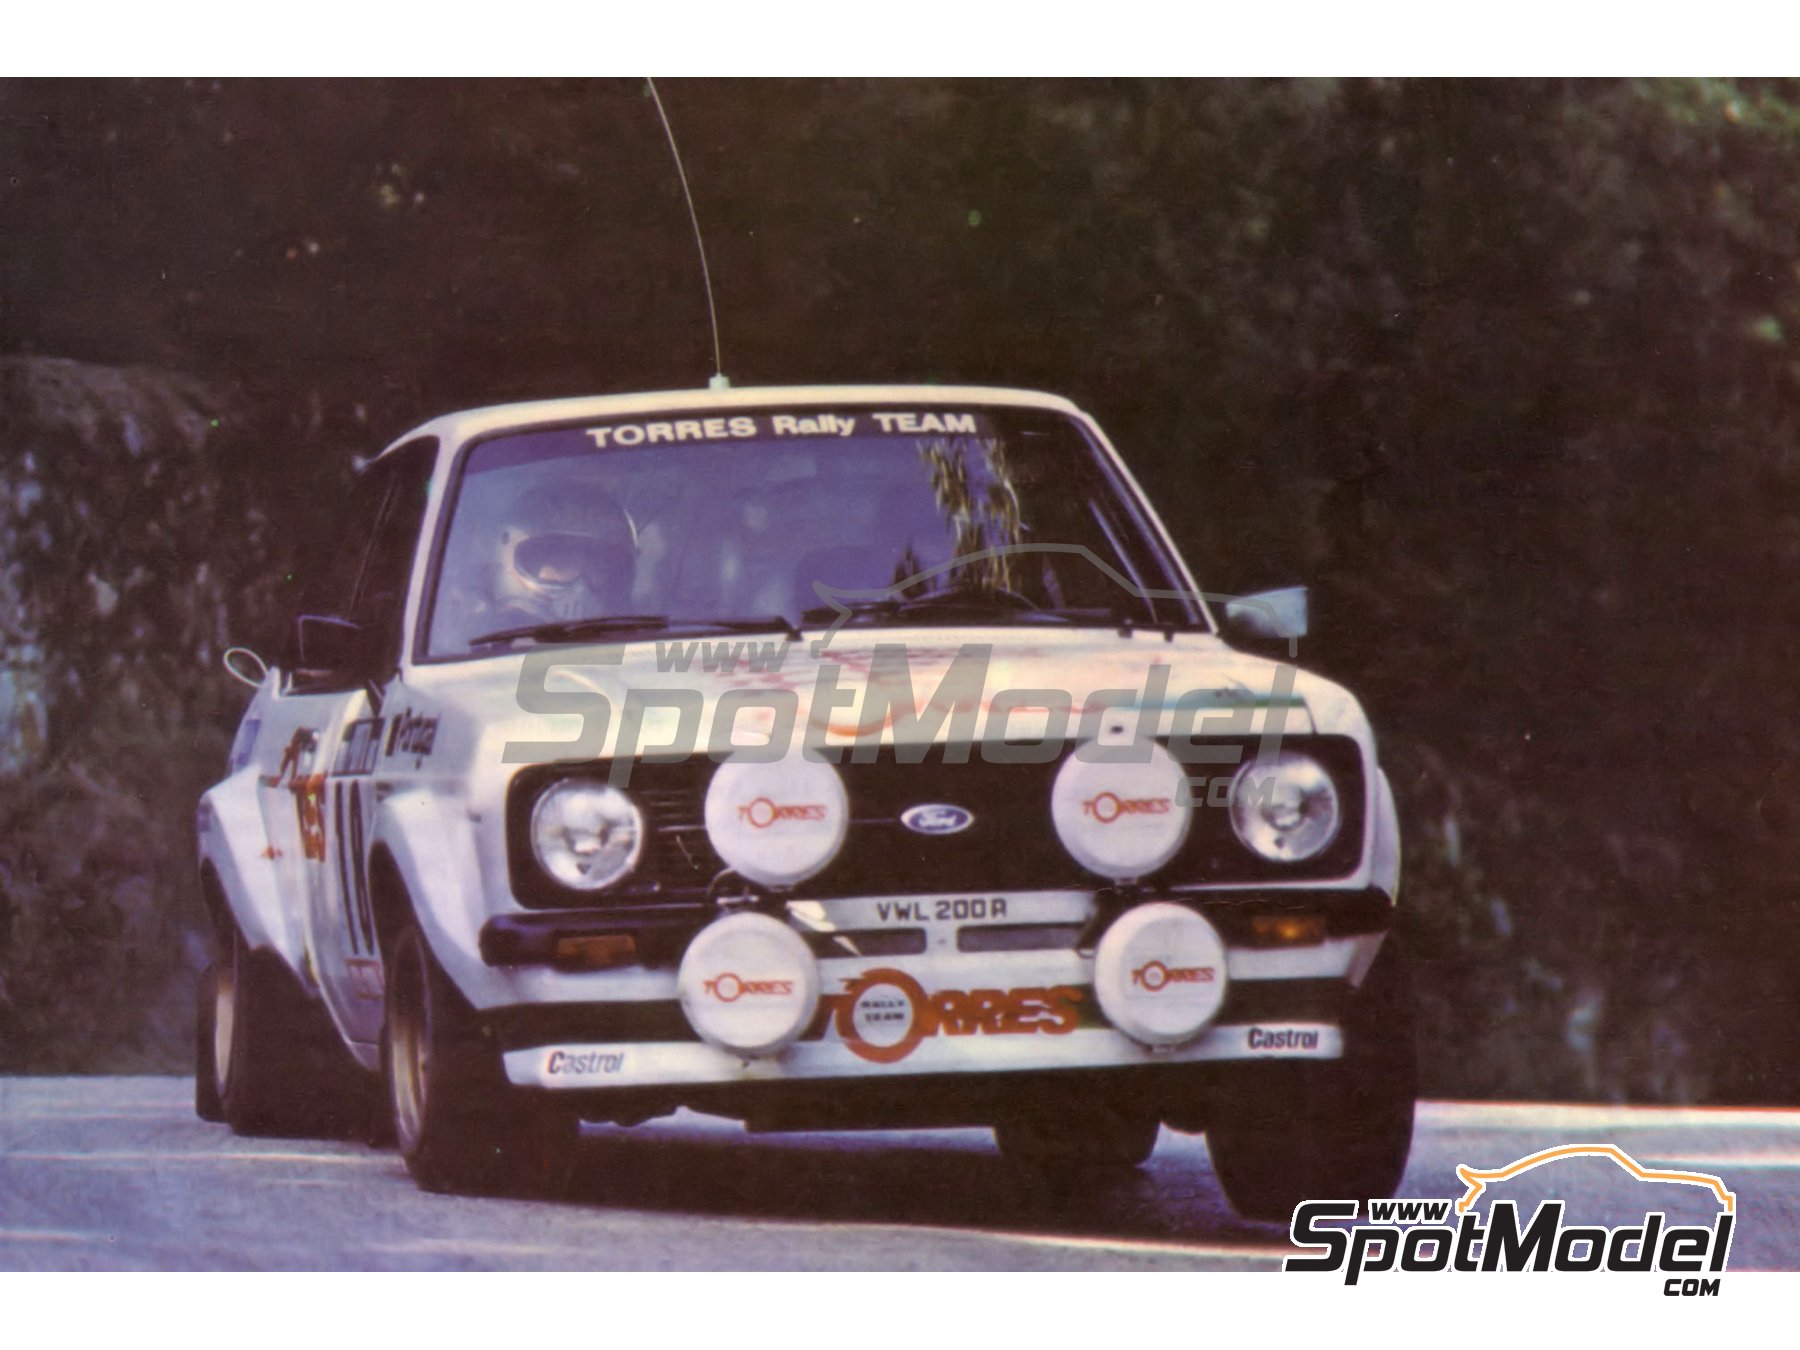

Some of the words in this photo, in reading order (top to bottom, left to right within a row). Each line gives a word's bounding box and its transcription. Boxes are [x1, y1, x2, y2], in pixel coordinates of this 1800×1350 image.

[586, 417, 757, 447] TORRES
[772, 414, 855, 437] Rally
[873, 413, 977, 433] TEAM
[877, 902, 930, 921] VWL
[1247, 1026, 1318, 1049] Castrol
[547, 1051, 624, 1074] Castrol
